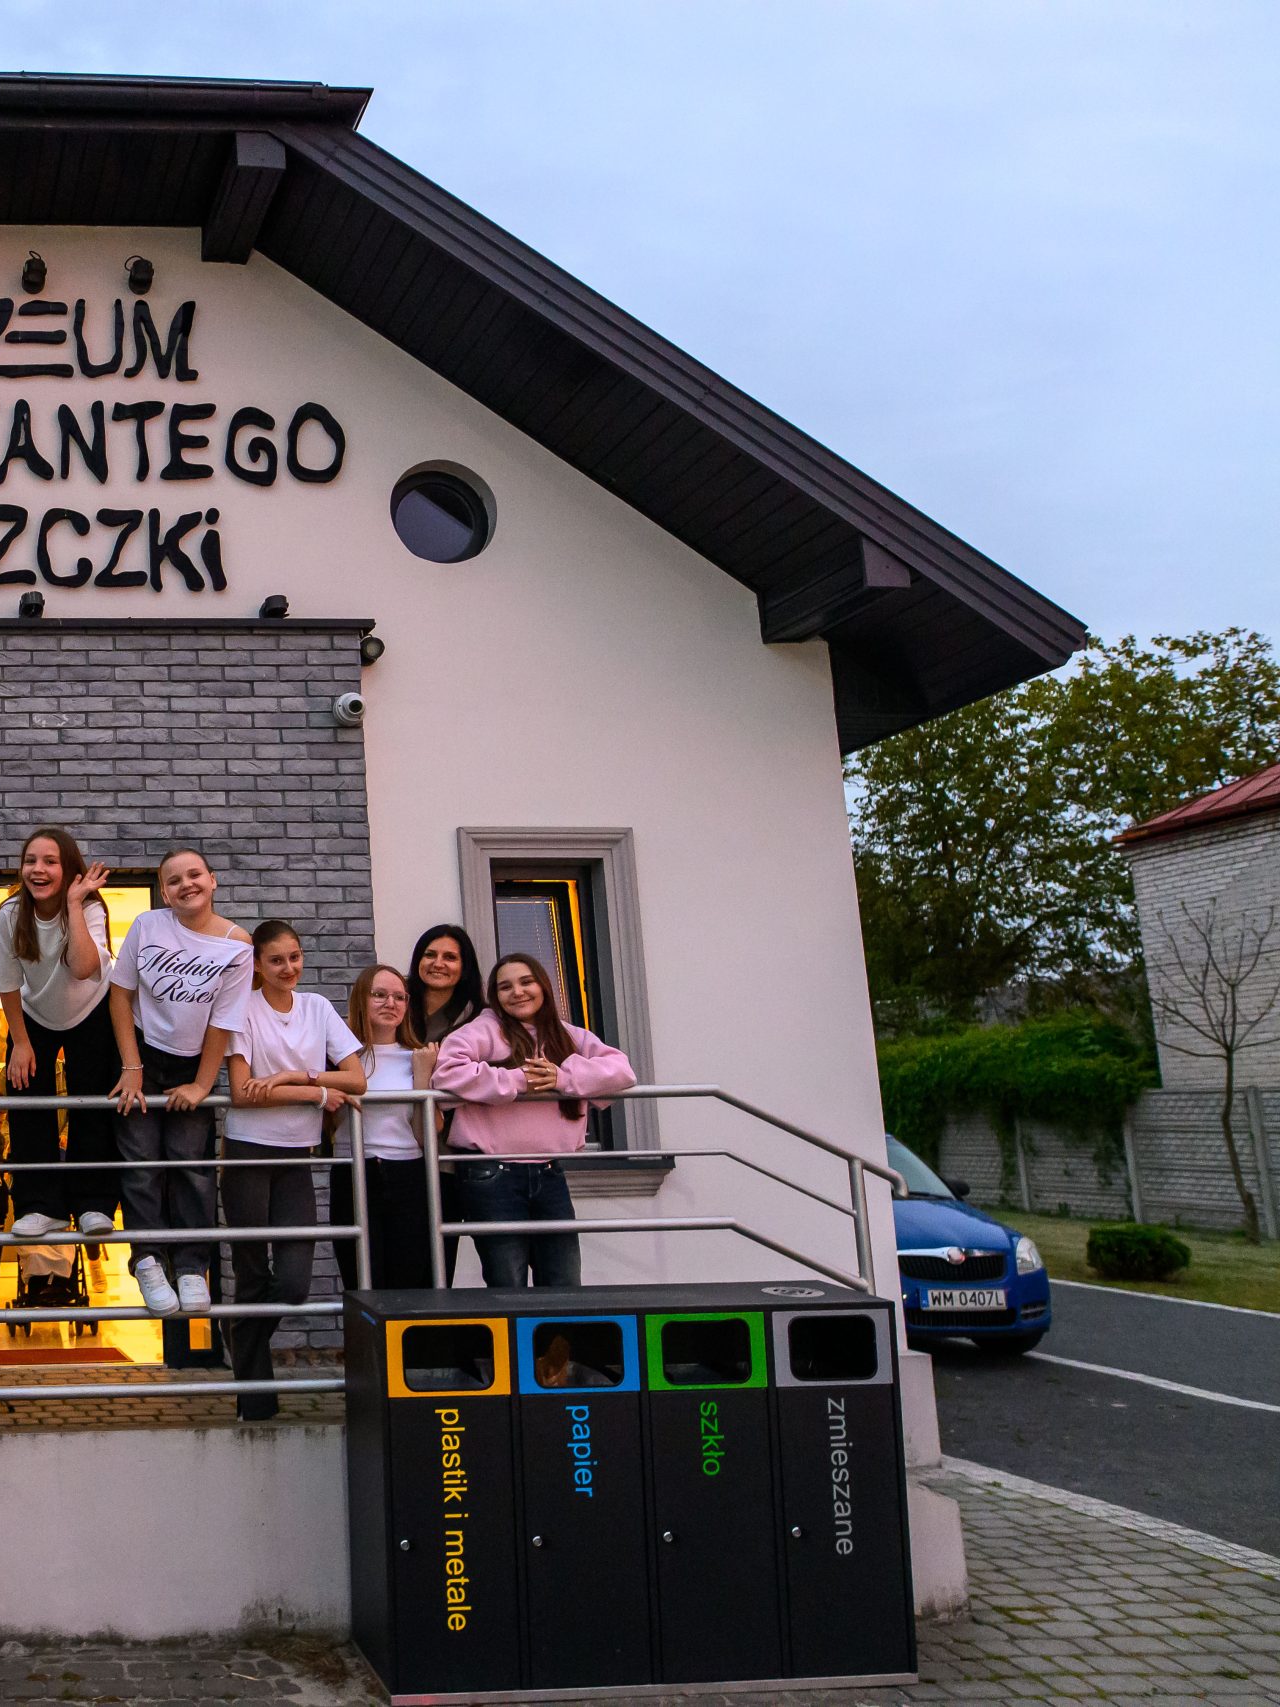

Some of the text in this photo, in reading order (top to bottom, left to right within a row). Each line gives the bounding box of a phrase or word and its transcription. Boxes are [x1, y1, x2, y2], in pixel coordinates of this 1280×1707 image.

[137, 945, 240, 986] Midnig
[152, 975, 218, 1004] Roses
[931, 1291, 1004, 1306] WM 0407L
[435, 1409, 468, 1502] plastik
[566, 1406, 597, 1498] papier
[700, 1402, 725, 1476] szkło
[827, 1398, 853, 1555] zmieszane
[444, 1531, 472, 1631] metale
